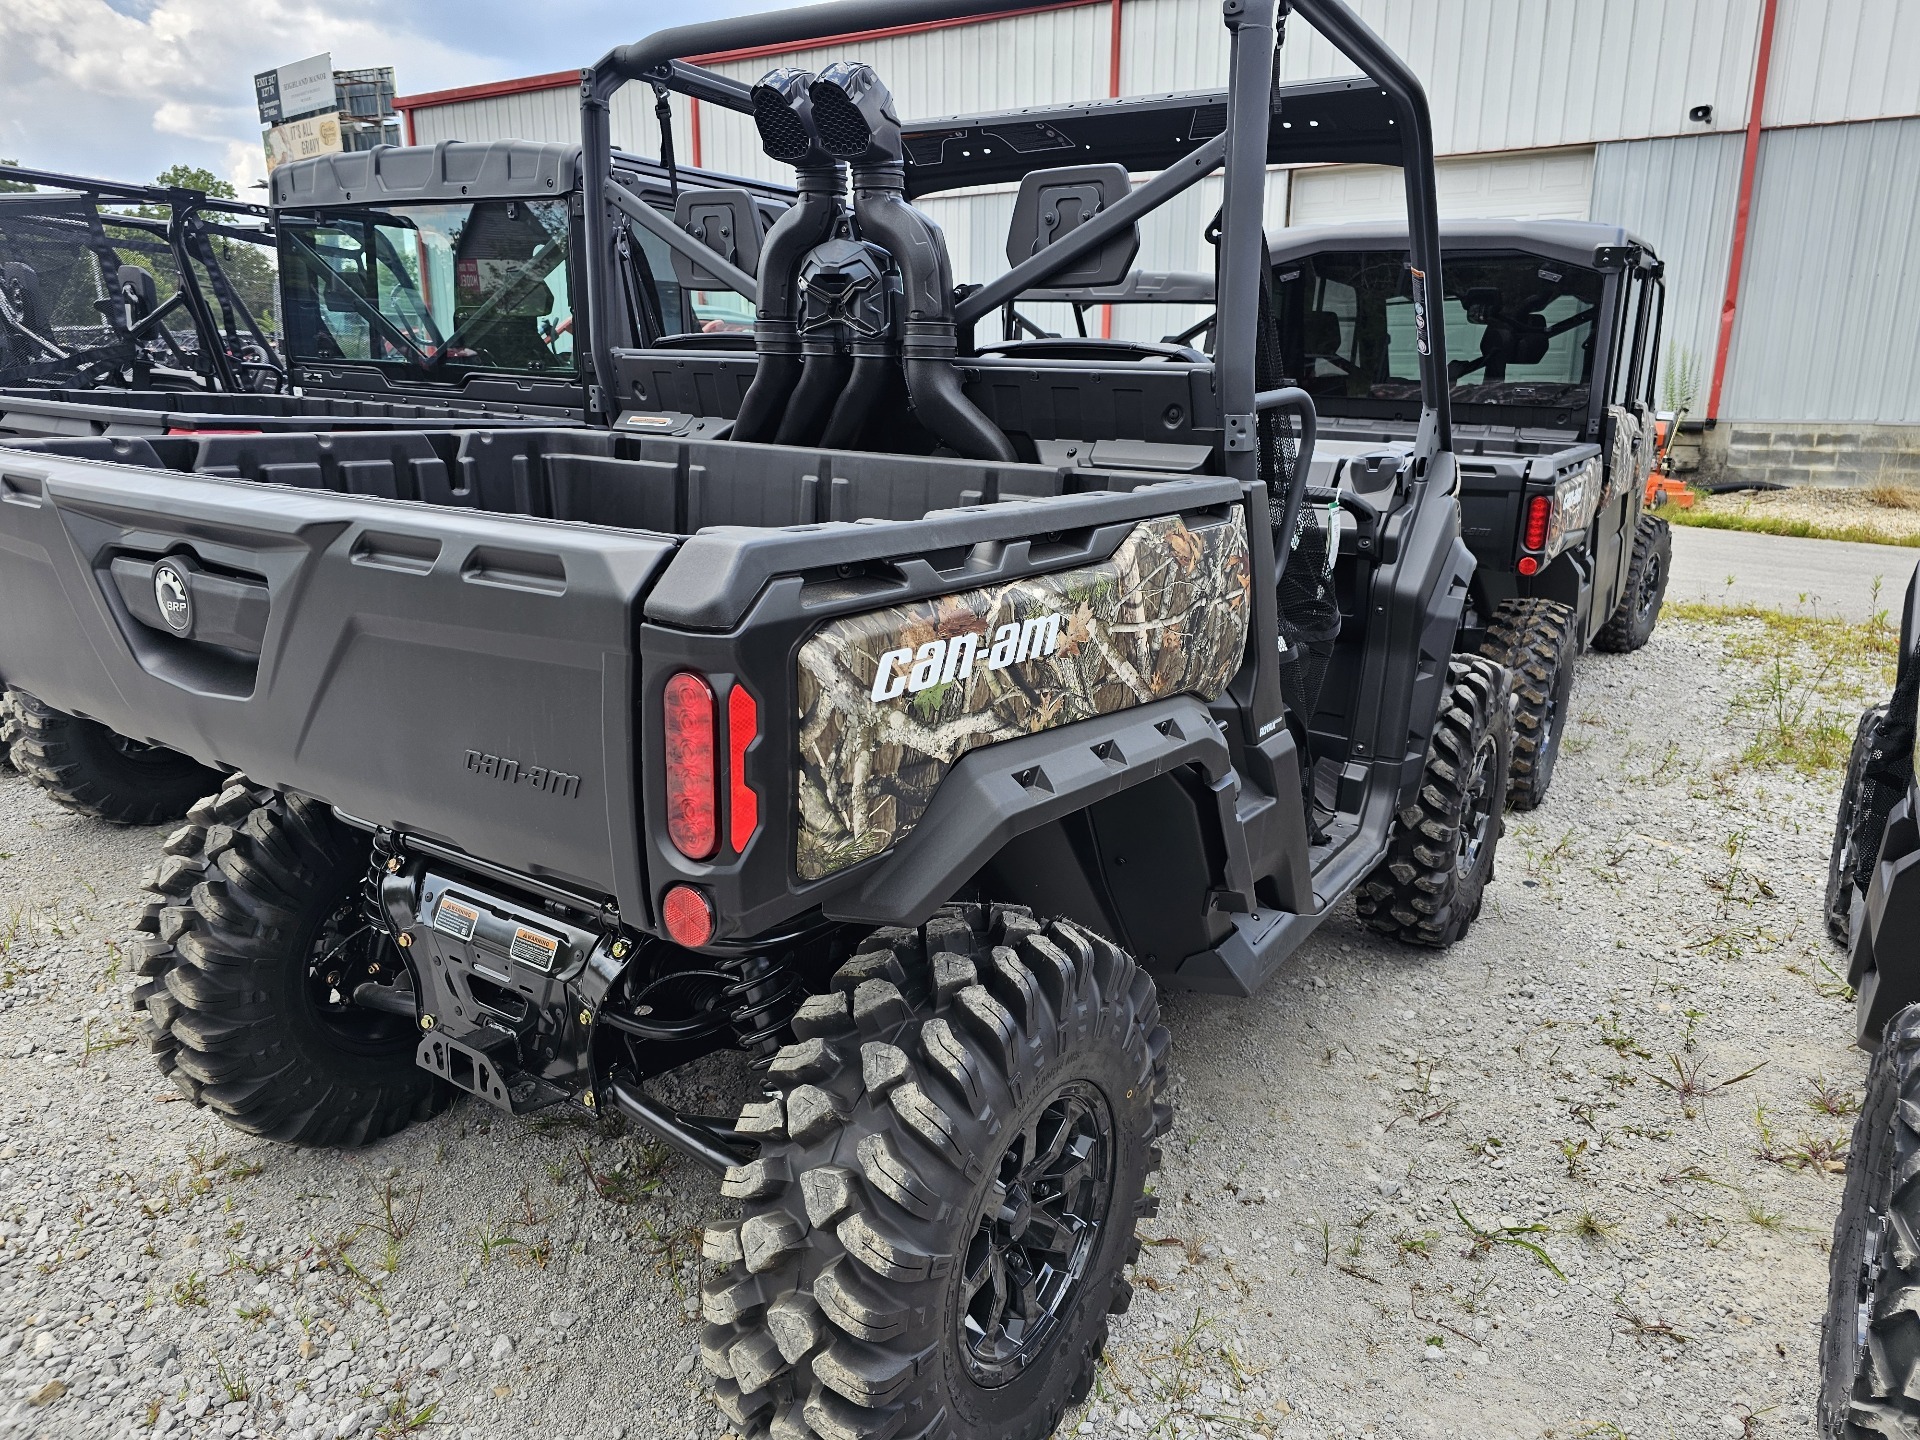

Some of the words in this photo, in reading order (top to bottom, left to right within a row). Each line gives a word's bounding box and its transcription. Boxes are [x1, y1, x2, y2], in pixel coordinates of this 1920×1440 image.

[291, 125, 301, 140] IT'S
[302, 121, 313, 136] ALL
[301, 138, 320, 155] GRAVY
[166, 601, 187, 612] BRP
[871, 613, 1060, 702] can-am
[463, 749, 581, 799] can-am
[451, 905, 472, 919] WARNING
[527, 934, 550, 947] WARNING
